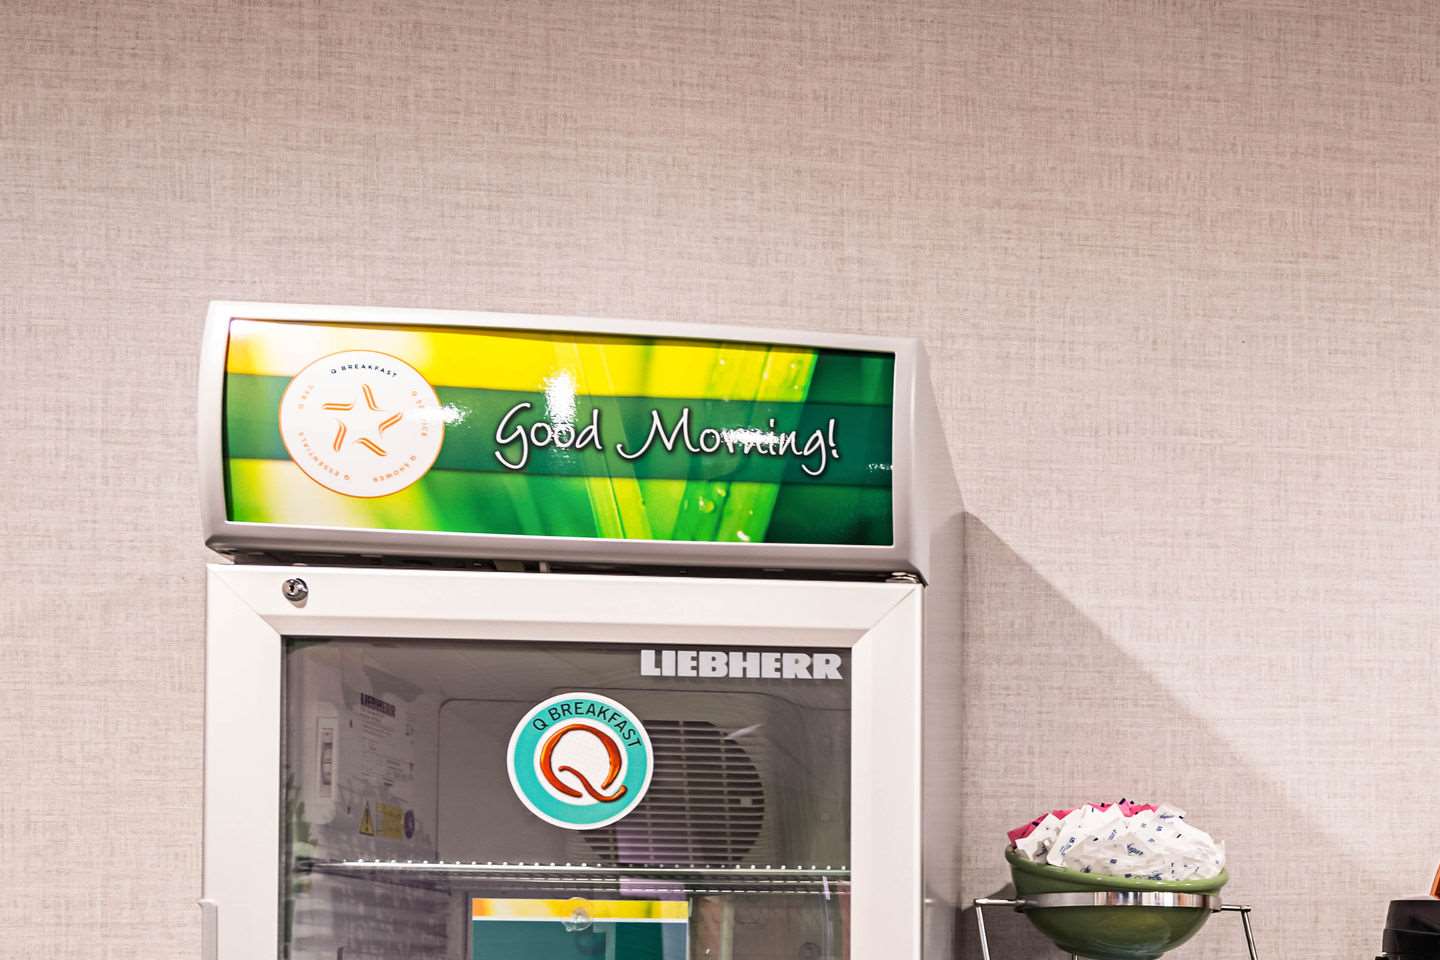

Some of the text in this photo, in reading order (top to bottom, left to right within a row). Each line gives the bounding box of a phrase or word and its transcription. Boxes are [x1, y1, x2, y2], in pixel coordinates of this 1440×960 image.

[495, 403, 603, 469] Good
[616, 408, 840, 476] Morning!
[640, 650, 843, 680] LIEBHERR
[533, 702, 643, 748] Q BREAKFAST
